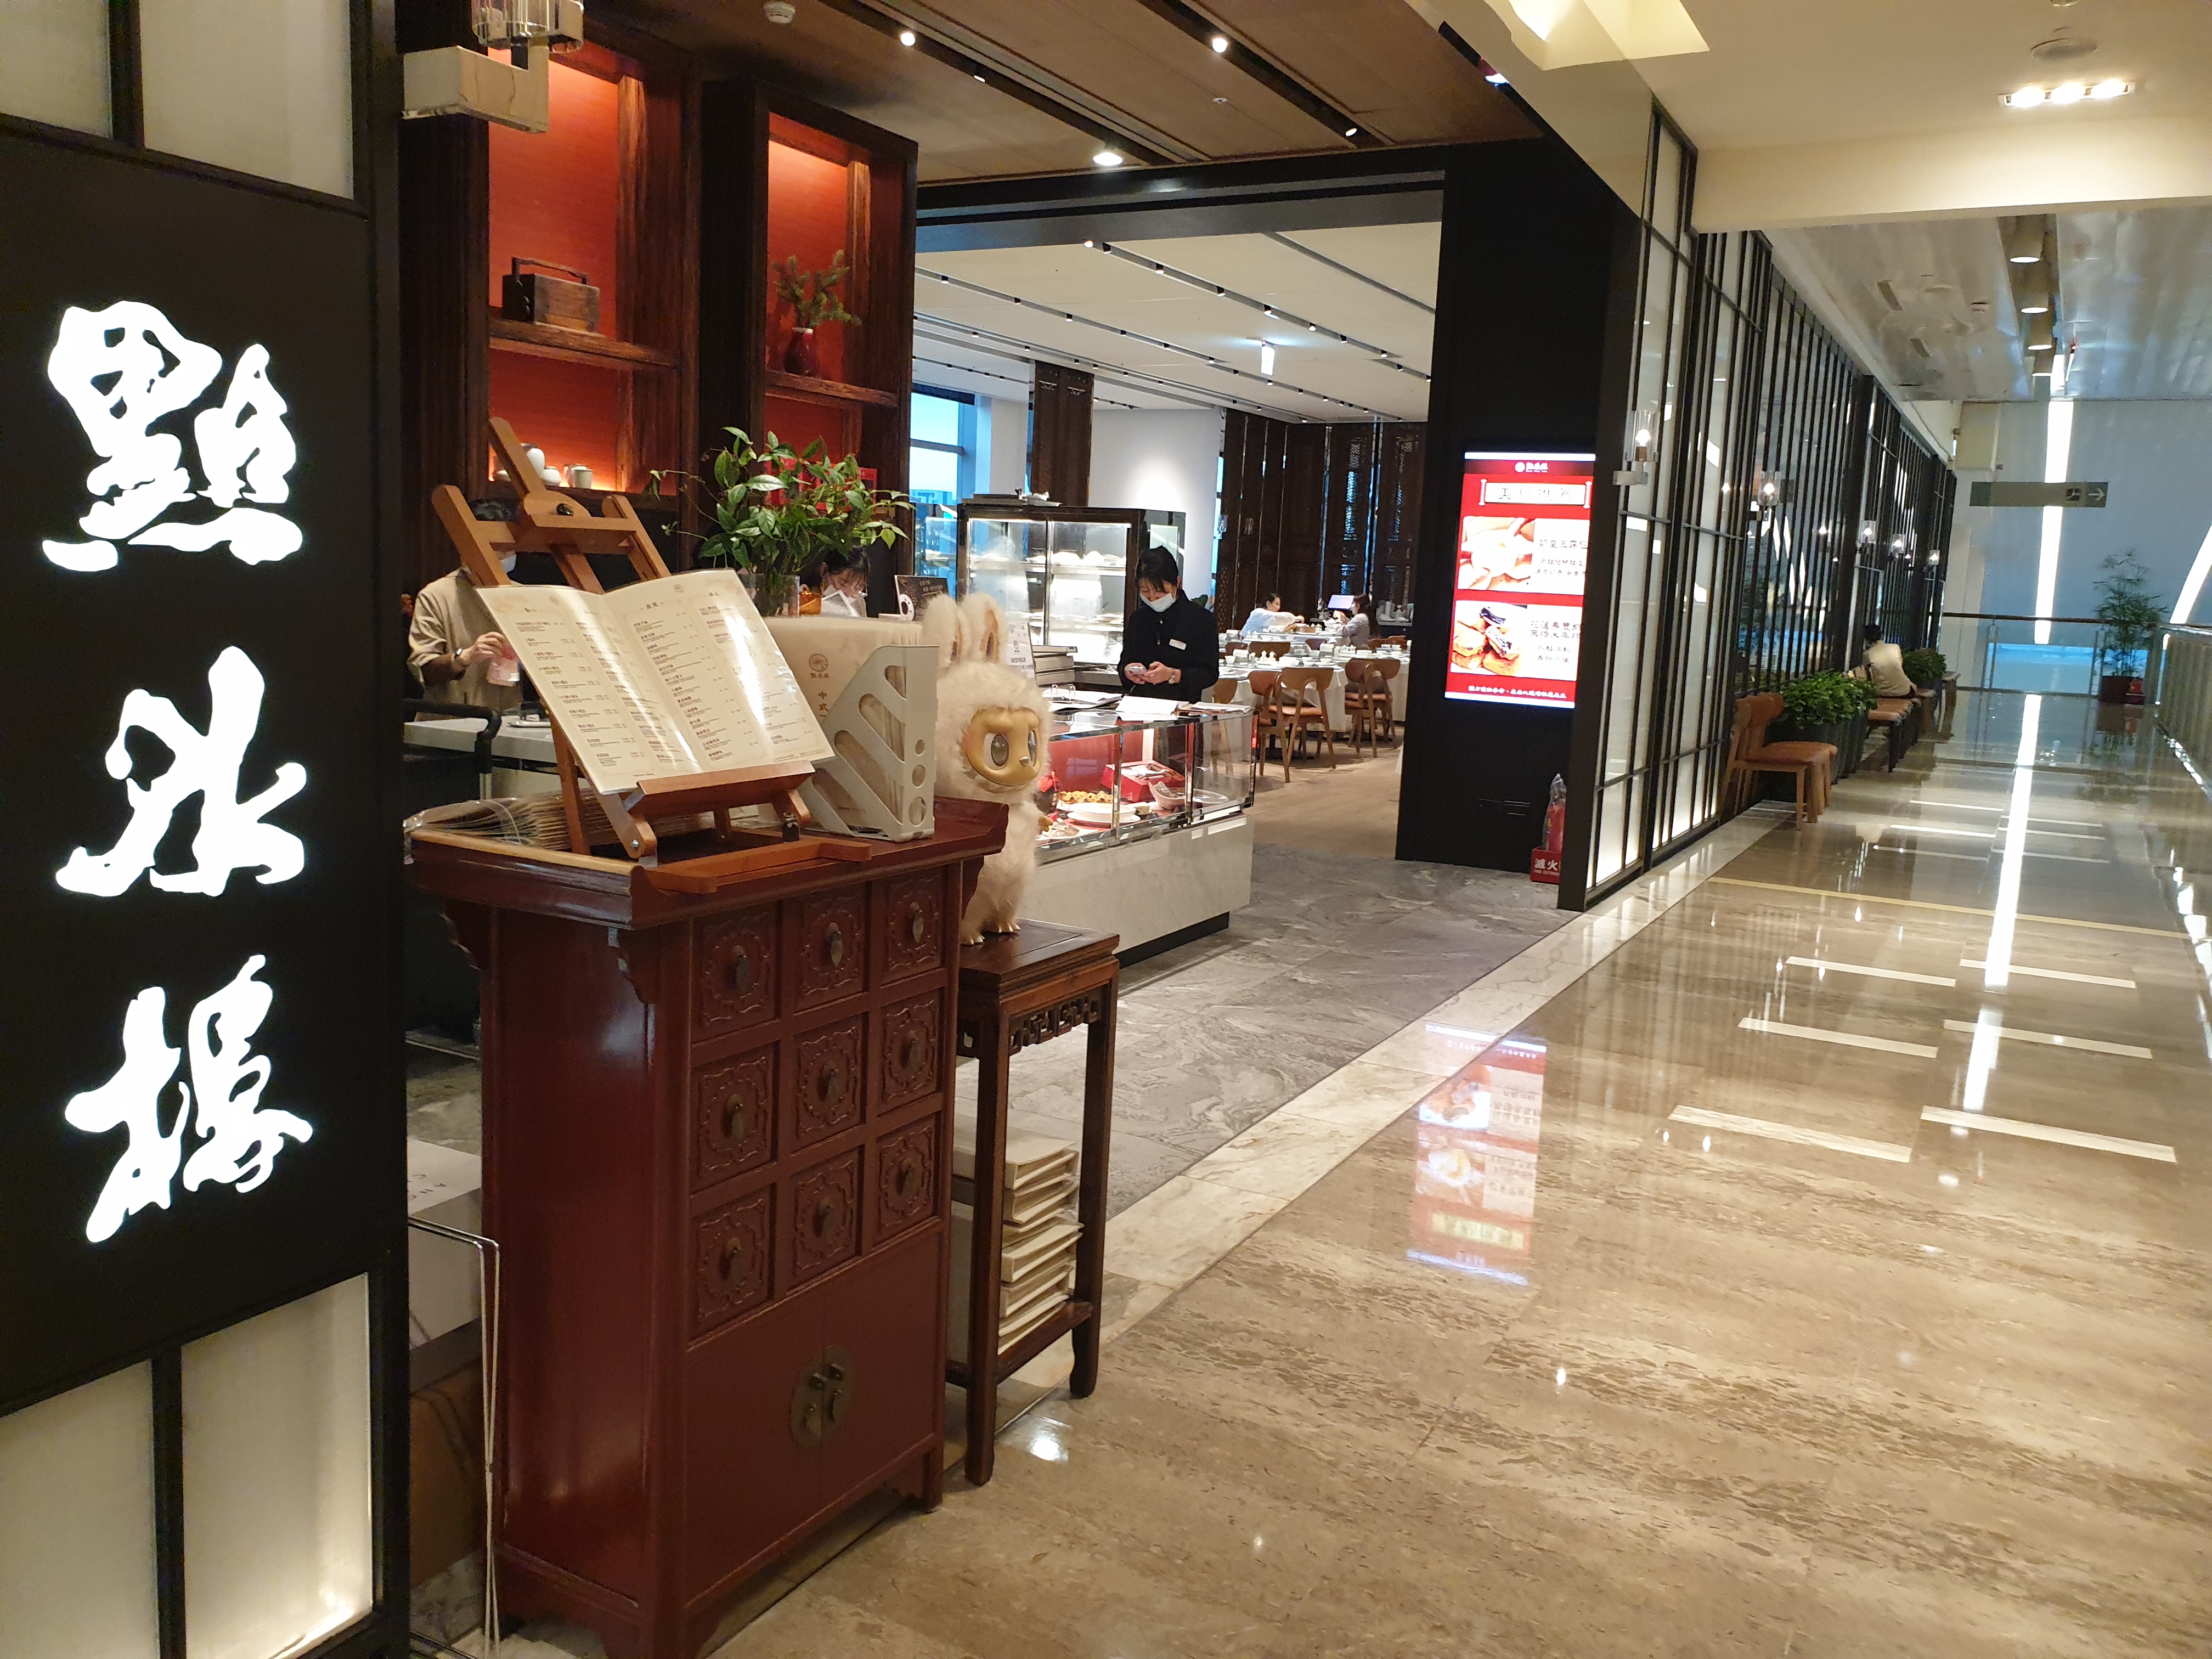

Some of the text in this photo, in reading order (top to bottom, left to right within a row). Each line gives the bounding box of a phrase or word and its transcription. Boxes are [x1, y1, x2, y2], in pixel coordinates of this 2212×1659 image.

[818, 691, 830, 717] 中式
[43, 301, 312, 1242] 點水樓
[1534, 858, 1561, 871] 滅火
